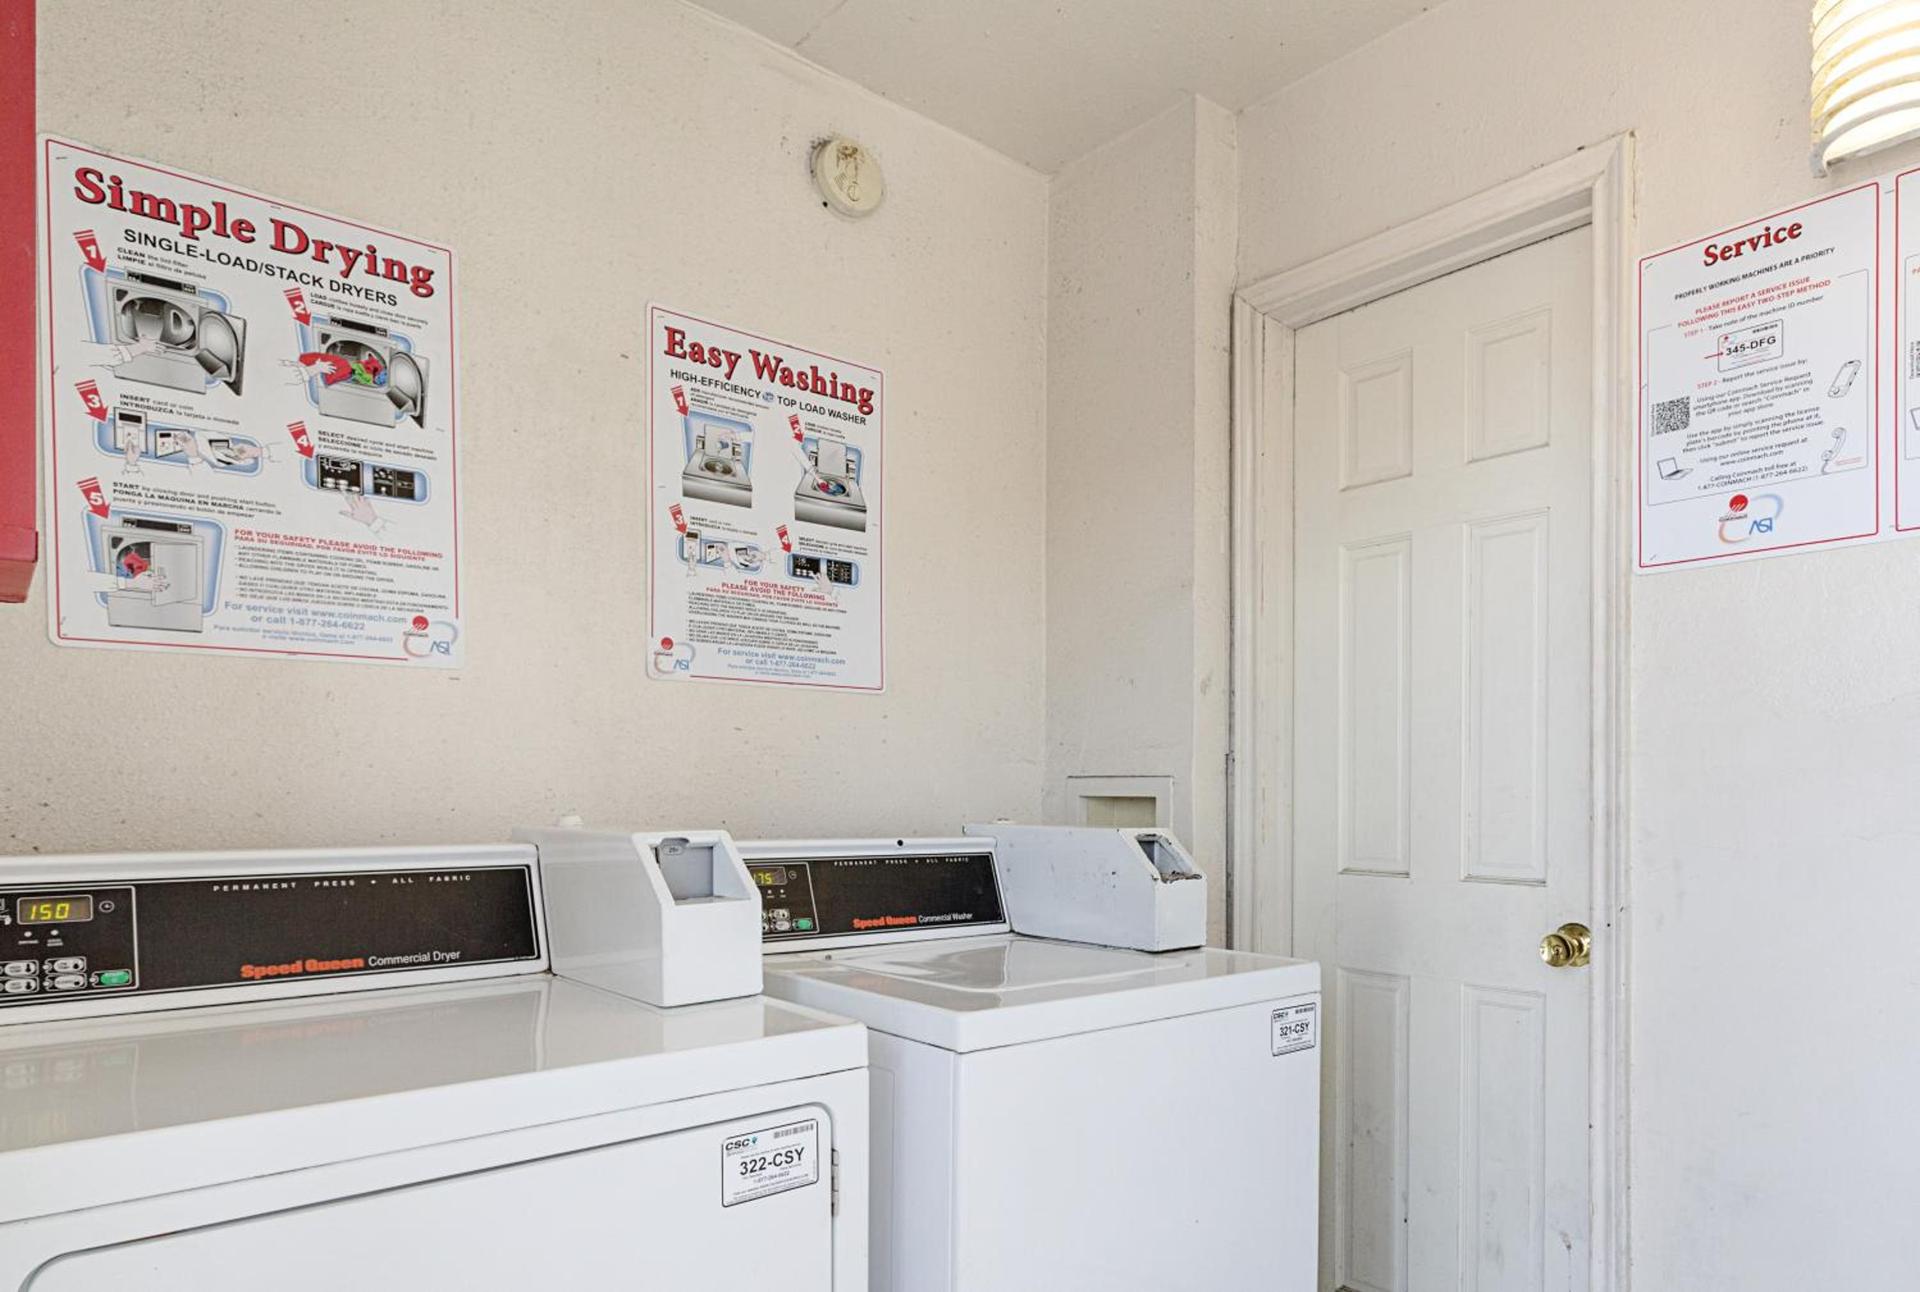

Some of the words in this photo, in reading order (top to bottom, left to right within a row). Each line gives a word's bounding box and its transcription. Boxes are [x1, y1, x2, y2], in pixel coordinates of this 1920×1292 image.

[74, 167, 256, 243] Simple
[269, 218, 435, 298] Drying
[117, 247, 145, 258] CLEAN
[1703, 222, 1803, 268] Service
[117, 254, 146, 267] LIMPIE
[124, 228, 324, 289] SINGLE-LOAD/STACK
[329, 279, 398, 306] DRYERS
[1674, 286, 1708, 300] PROPERLY
[1708, 276, 1741, 290] WORKING
[1741, 265, 1778, 280] MACHINES
[1779, 259, 1793, 268] ARE
[1800, 246, 1836, 262] PRIORITY
[1678, 312, 1719, 328] FOLLOWING
[1720, 307, 1736, 316] THIS
[1737, 301, 1756, 312] EASY
[1758, 289, 1795, 305] TWO-STEP
[1797, 280, 1831, 293] METHOD
[1695, 302, 1720, 315] PLEASE
[1722, 294, 1749, 306] REPORT
[1757, 282, 1788, 296] SERVICE
[1788, 276, 1811, 288] ISSUE
[1759, 306, 1786, 316] machine
[1796, 295, 1824, 306] number
[1725, 335, 1776, 356] 345-DFG
[664, 325, 742, 381] Easy
[748, 349, 874, 415] Washing
[1722, 374, 1743, 383] Report
[87, 394, 100, 407] 3
[120, 393, 150, 403] INSERT
[670, 369, 761, 398] HIGH-EFFICIENCY
[777, 395, 797, 407] TOP
[799, 402, 826, 415] LOAD
[827, 408, 866, 425] WASHER
[120, 401, 174, 415] INTRODUZCA
[1782, 424, 1804, 432] service
[1783, 417, 1804, 426] phone
[317, 430, 344, 439] SELECT
[318, 436, 361, 448] SELECCIONE
[1752, 445, 1773, 453] service
[1775, 438, 1799, 448] request
[89, 492, 102, 505] 5
[113, 481, 140, 490] START
[152, 486, 178, 496] closing
[211, 494, 237, 503] pushing
[113, 488, 143, 498] PONGA
[210, 501, 244, 511] MARCHA
[1748, 517, 1773, 535] ASI
[256, 531, 280, 539] YOUR
[283, 535, 316, 543] SAFETY
[318, 538, 350, 547] PLEASE
[353, 543, 378, 551] AVOID
[397, 547, 443, 558] FOLLOWING
[721, 582, 747, 591] PLEASE
[749, 586, 771, 594] AVOID
[787, 590, 825, 601] FOLLOWING
[760, 581, 778, 589] YOUR
[780, 584, 805, 592] SAFETY
[224, 601, 243, 610] For
[246, 604, 284, 613] service
[287, 607, 308, 616] visit
[312, 609, 407, 623] www.coinmach.com
[266, 616, 286, 624] call
[717, 647, 731, 656] For
[732, 648, 760, 658] service
[761, 652, 776, 660] visit
[213, 881, 298, 892] PERMANENT
[314, 879, 356, 888] PRESS
[428, 874, 472, 883] FABRIC
[29, 903, 70, 920] 150
[853, 916, 885, 930] Speed
[886, 914, 918, 927] Queen
[918, 912, 951, 924] Commercial
[952, 911, 973, 920] Washer
[240, 960, 303, 979] Speed
[304, 957, 365, 973] Queen
[367, 951, 431, 967] Commercial
[433, 949, 461, 963] Dryer
[1279, 1021, 1310, 1037] 321-CSY
[725, 1138, 750, 1151] CSC
[739, 1146, 805, 1176] 322-CSY
